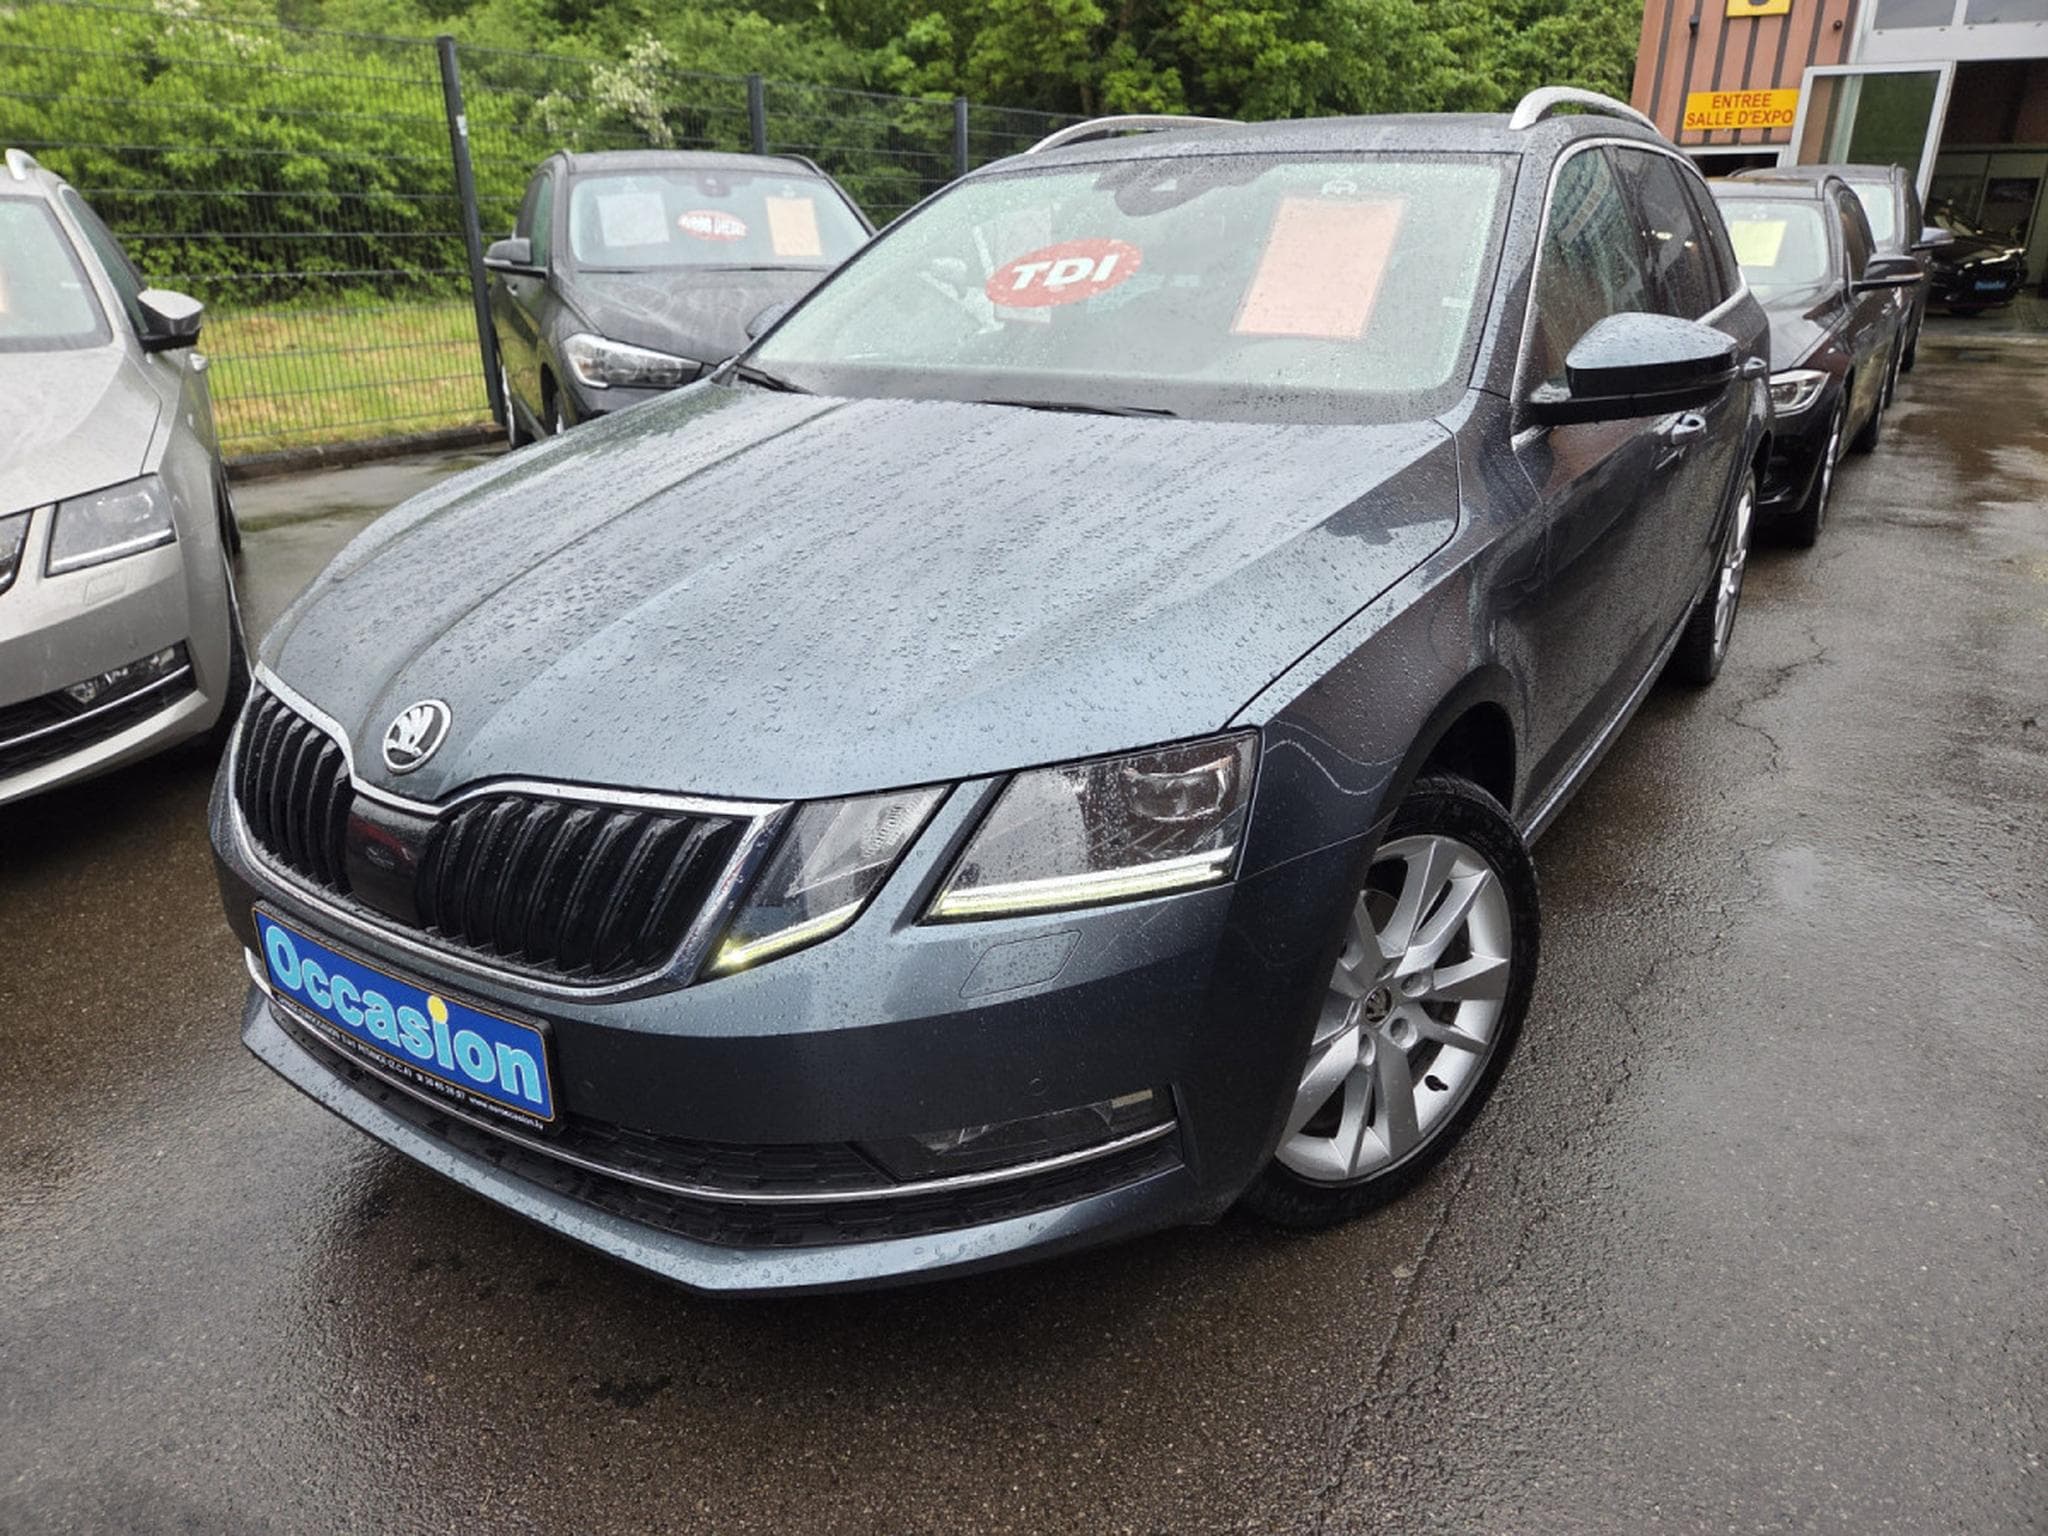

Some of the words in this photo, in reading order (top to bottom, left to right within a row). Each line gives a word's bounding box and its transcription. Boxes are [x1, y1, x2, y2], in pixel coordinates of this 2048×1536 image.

[1711, 92, 1772, 109] ENTREE
[1686, 111, 1734, 127] SALLE
[1737, 109, 1793, 124] D'EXPO
[1011, 253, 1120, 291] TDI
[265, 924, 543, 1104] Occasion
